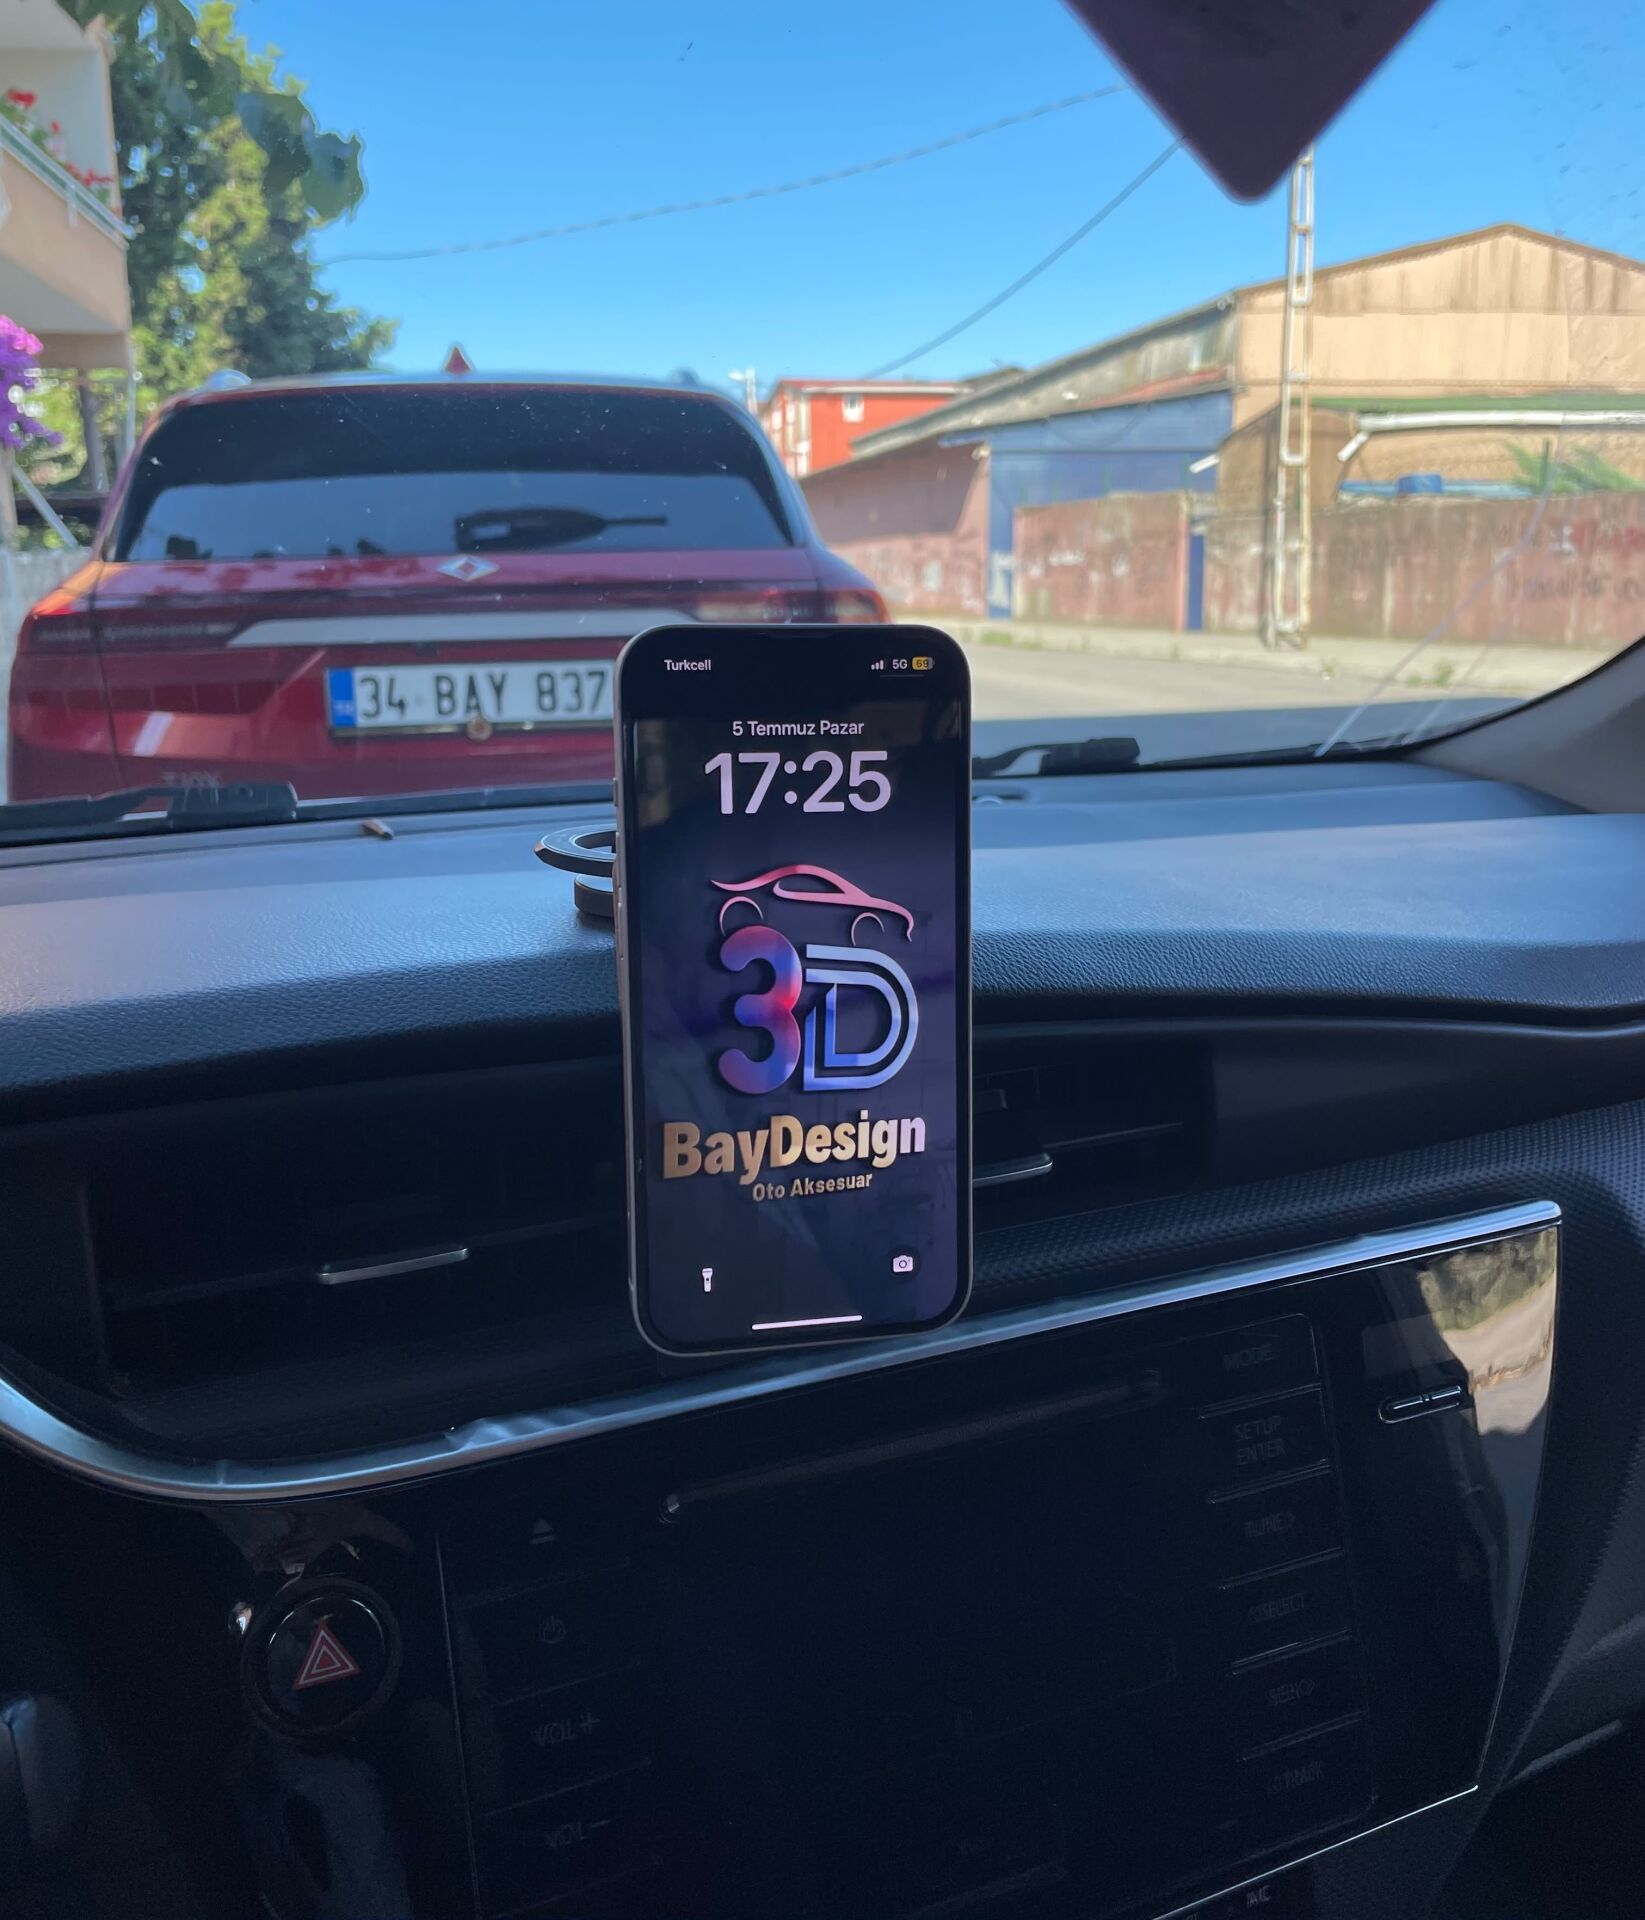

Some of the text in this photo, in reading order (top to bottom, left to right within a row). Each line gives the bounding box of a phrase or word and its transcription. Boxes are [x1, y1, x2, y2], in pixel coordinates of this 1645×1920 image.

[664, 659, 712, 671] Turkcell
[892, 658, 908, 670] 5G
[359, 671, 609, 718] 34 BAY 837
[732, 720, 864, 736] 5 Temmuz Pazar
[705, 750, 891, 814] 17:25
[718, 924, 919, 1094] 3D
[663, 1110, 926, 1185] BayDesign
[752, 1172, 873, 1202] Oto Aksesuar
[1223, 1342, 1274, 1371] MODE
[1234, 1414, 1282, 1442] SETUP
